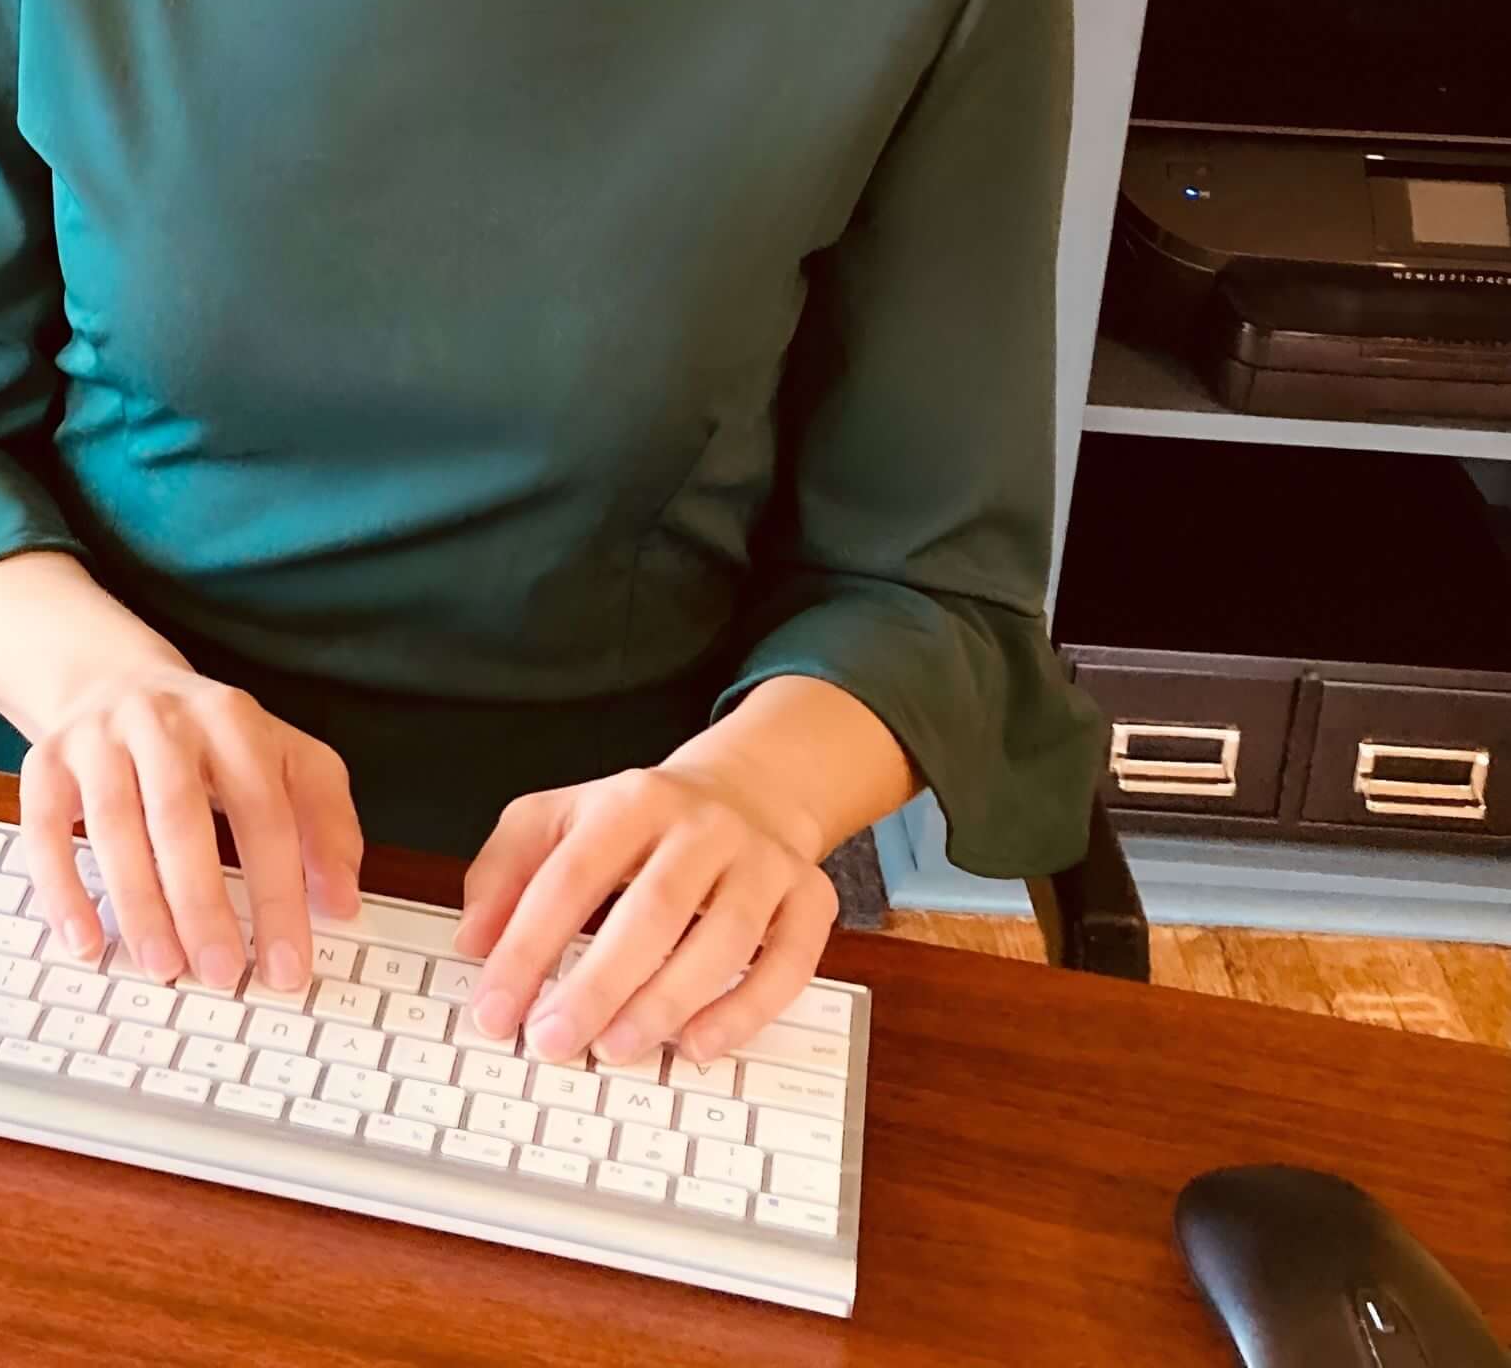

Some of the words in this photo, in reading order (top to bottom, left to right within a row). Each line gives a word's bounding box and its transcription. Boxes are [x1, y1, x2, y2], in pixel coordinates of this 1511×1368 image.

[318, 947, 335, 962] N
[386, 961, 401, 974] B
[454, 975, 470, 987] V
[65, 982, 83, 995] P
[131, 994, 150, 1008] O
[340, 995, 356, 1007] H
[407, 1007, 425, 1021] G
[272, 1022, 289, 1037] U
[342, 1038, 359, 1051] Y
[416, 1051, 427, 1065] T
[485, 1065, 502, 1079] R
[696, 1062, 712, 1076] A
[559, 1080, 575, 1093] E
[627, 1092, 651, 1109] W
[706, 1107, 725, 1121] Q
